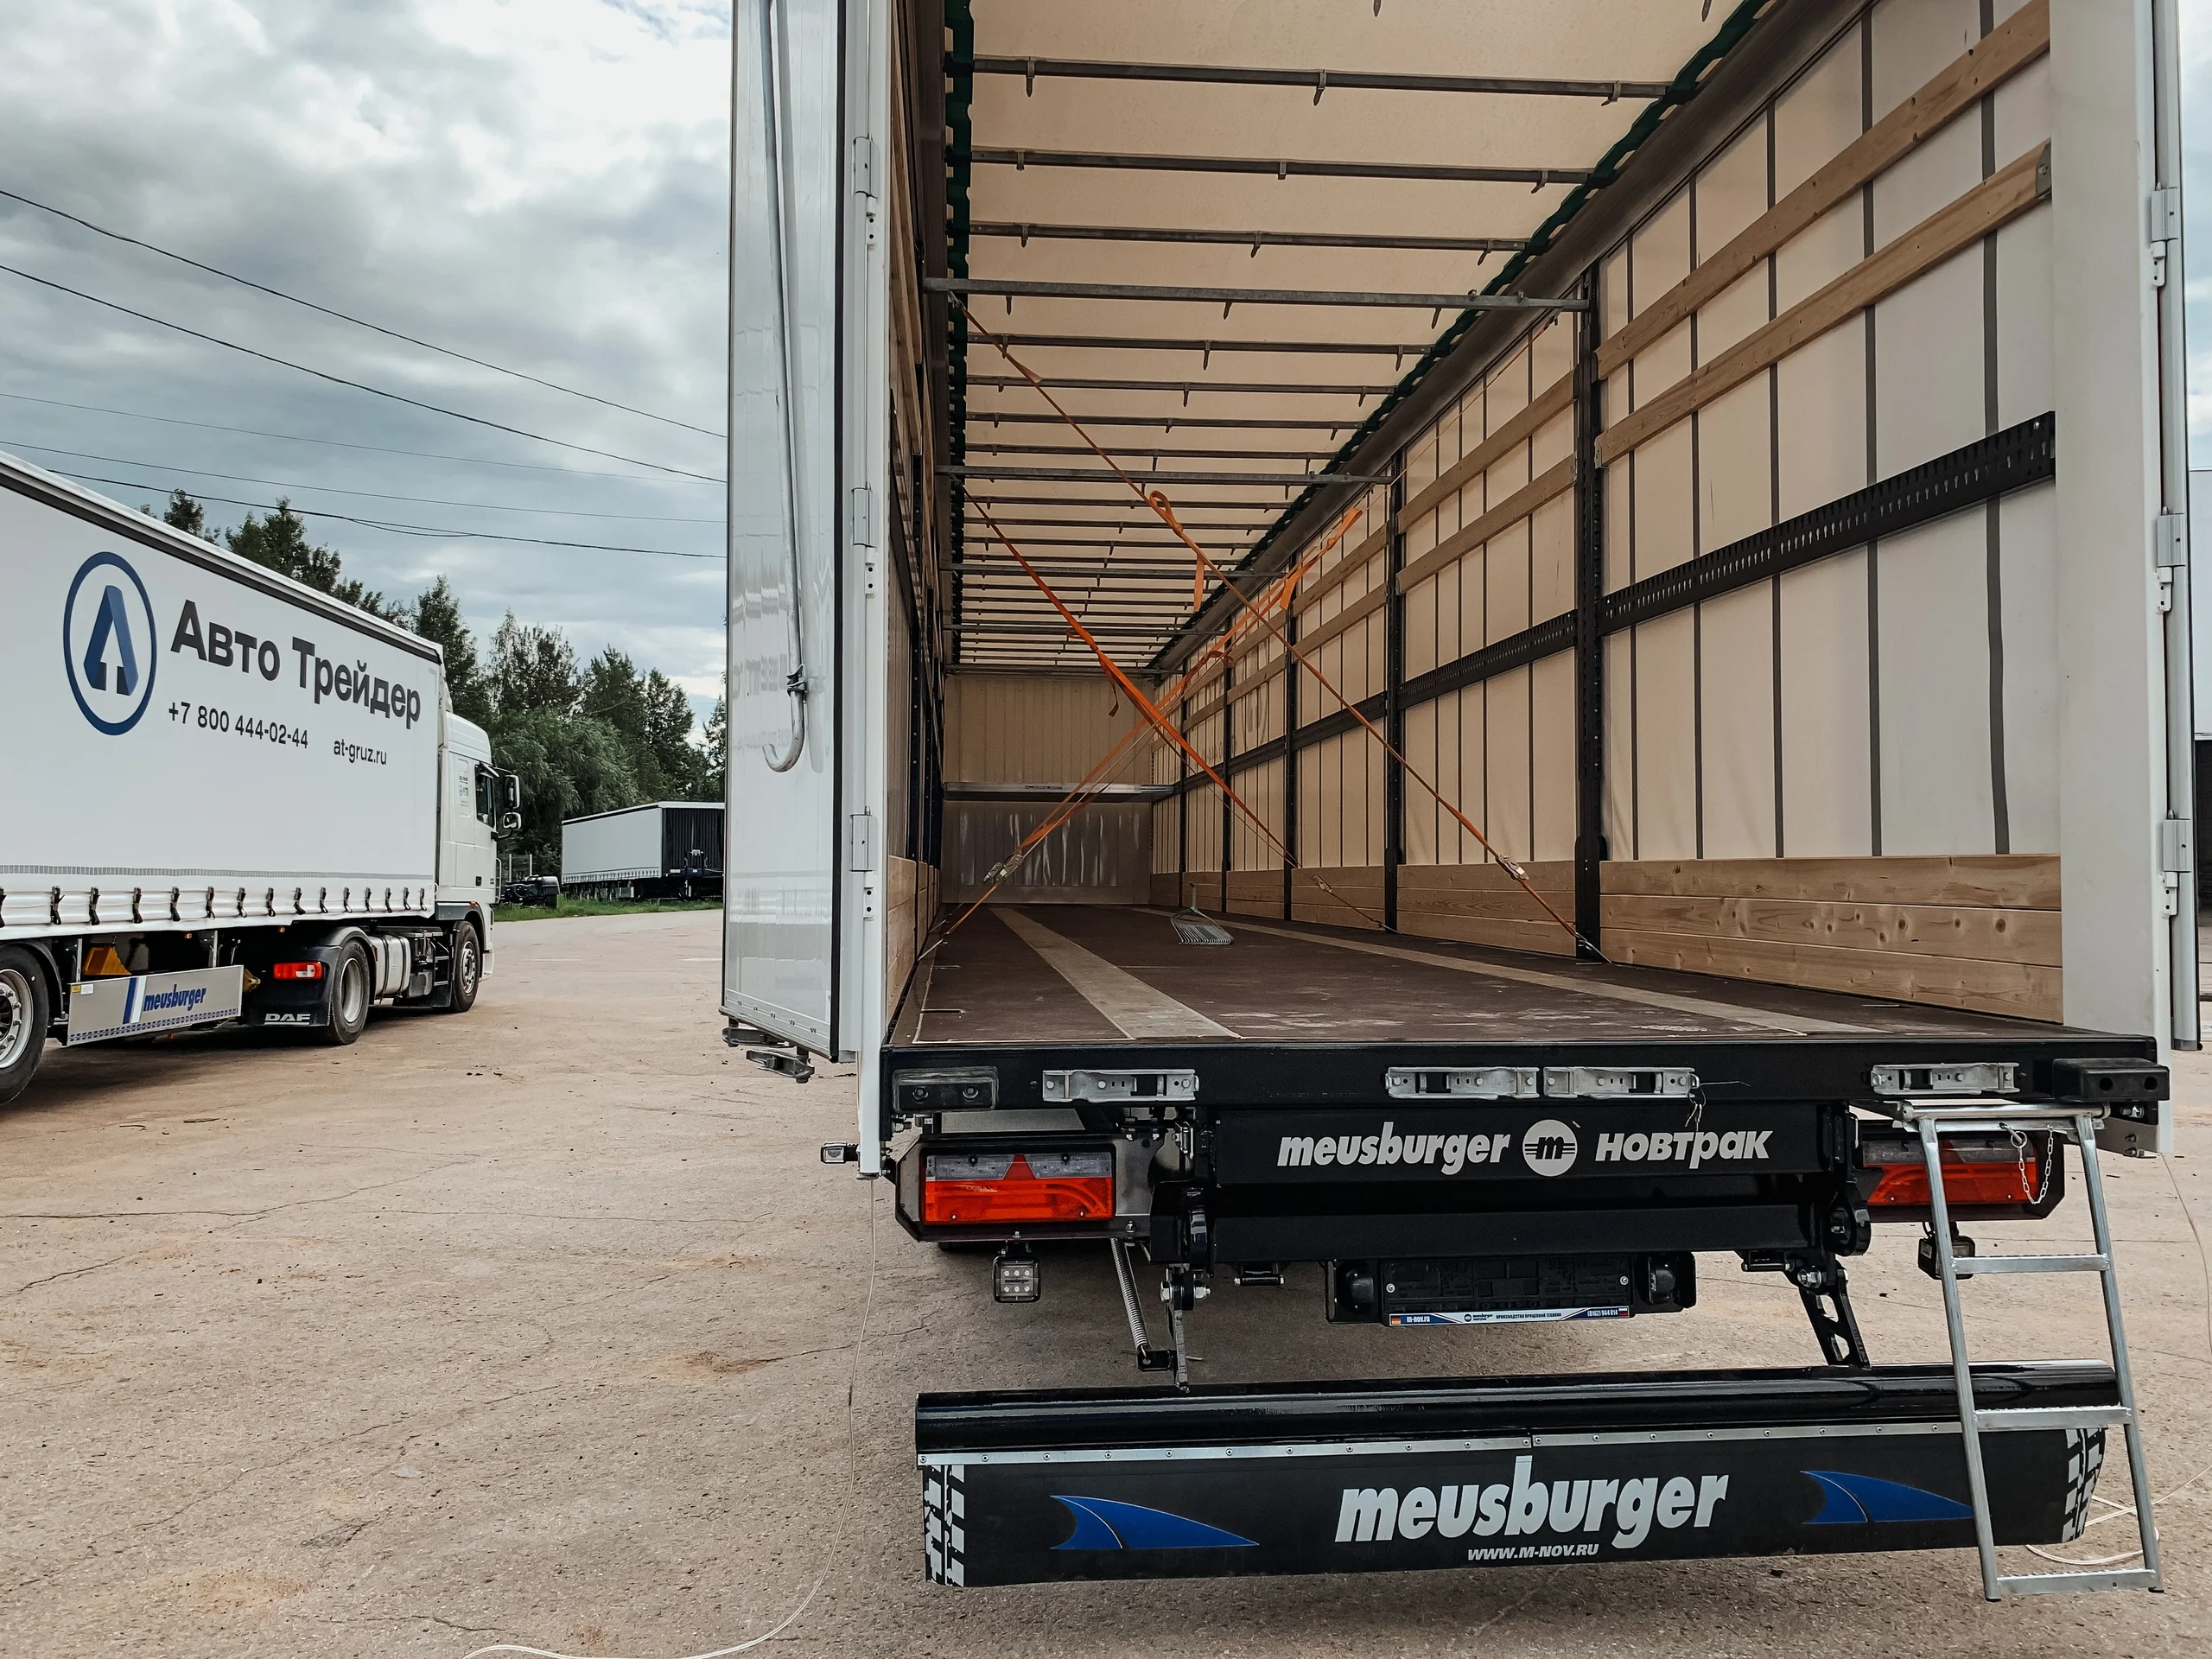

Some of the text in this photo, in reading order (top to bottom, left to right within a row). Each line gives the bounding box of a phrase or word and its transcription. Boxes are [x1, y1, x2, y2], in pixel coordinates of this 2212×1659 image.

[170, 599, 421, 729] Авто Трейдер
[168, 702, 308, 749] +7 800 444-02-44
[334, 739, 387, 766] at-gruz.ru
[143, 984, 207, 1012] meusburger
[264, 1013, 311, 1022] DAF
[1277, 1122, 1511, 1175] meusburger
[1334, 1455, 1730, 1549] meusburger
[1467, 1543, 1599, 1560] WWW.M-NOV.RU
